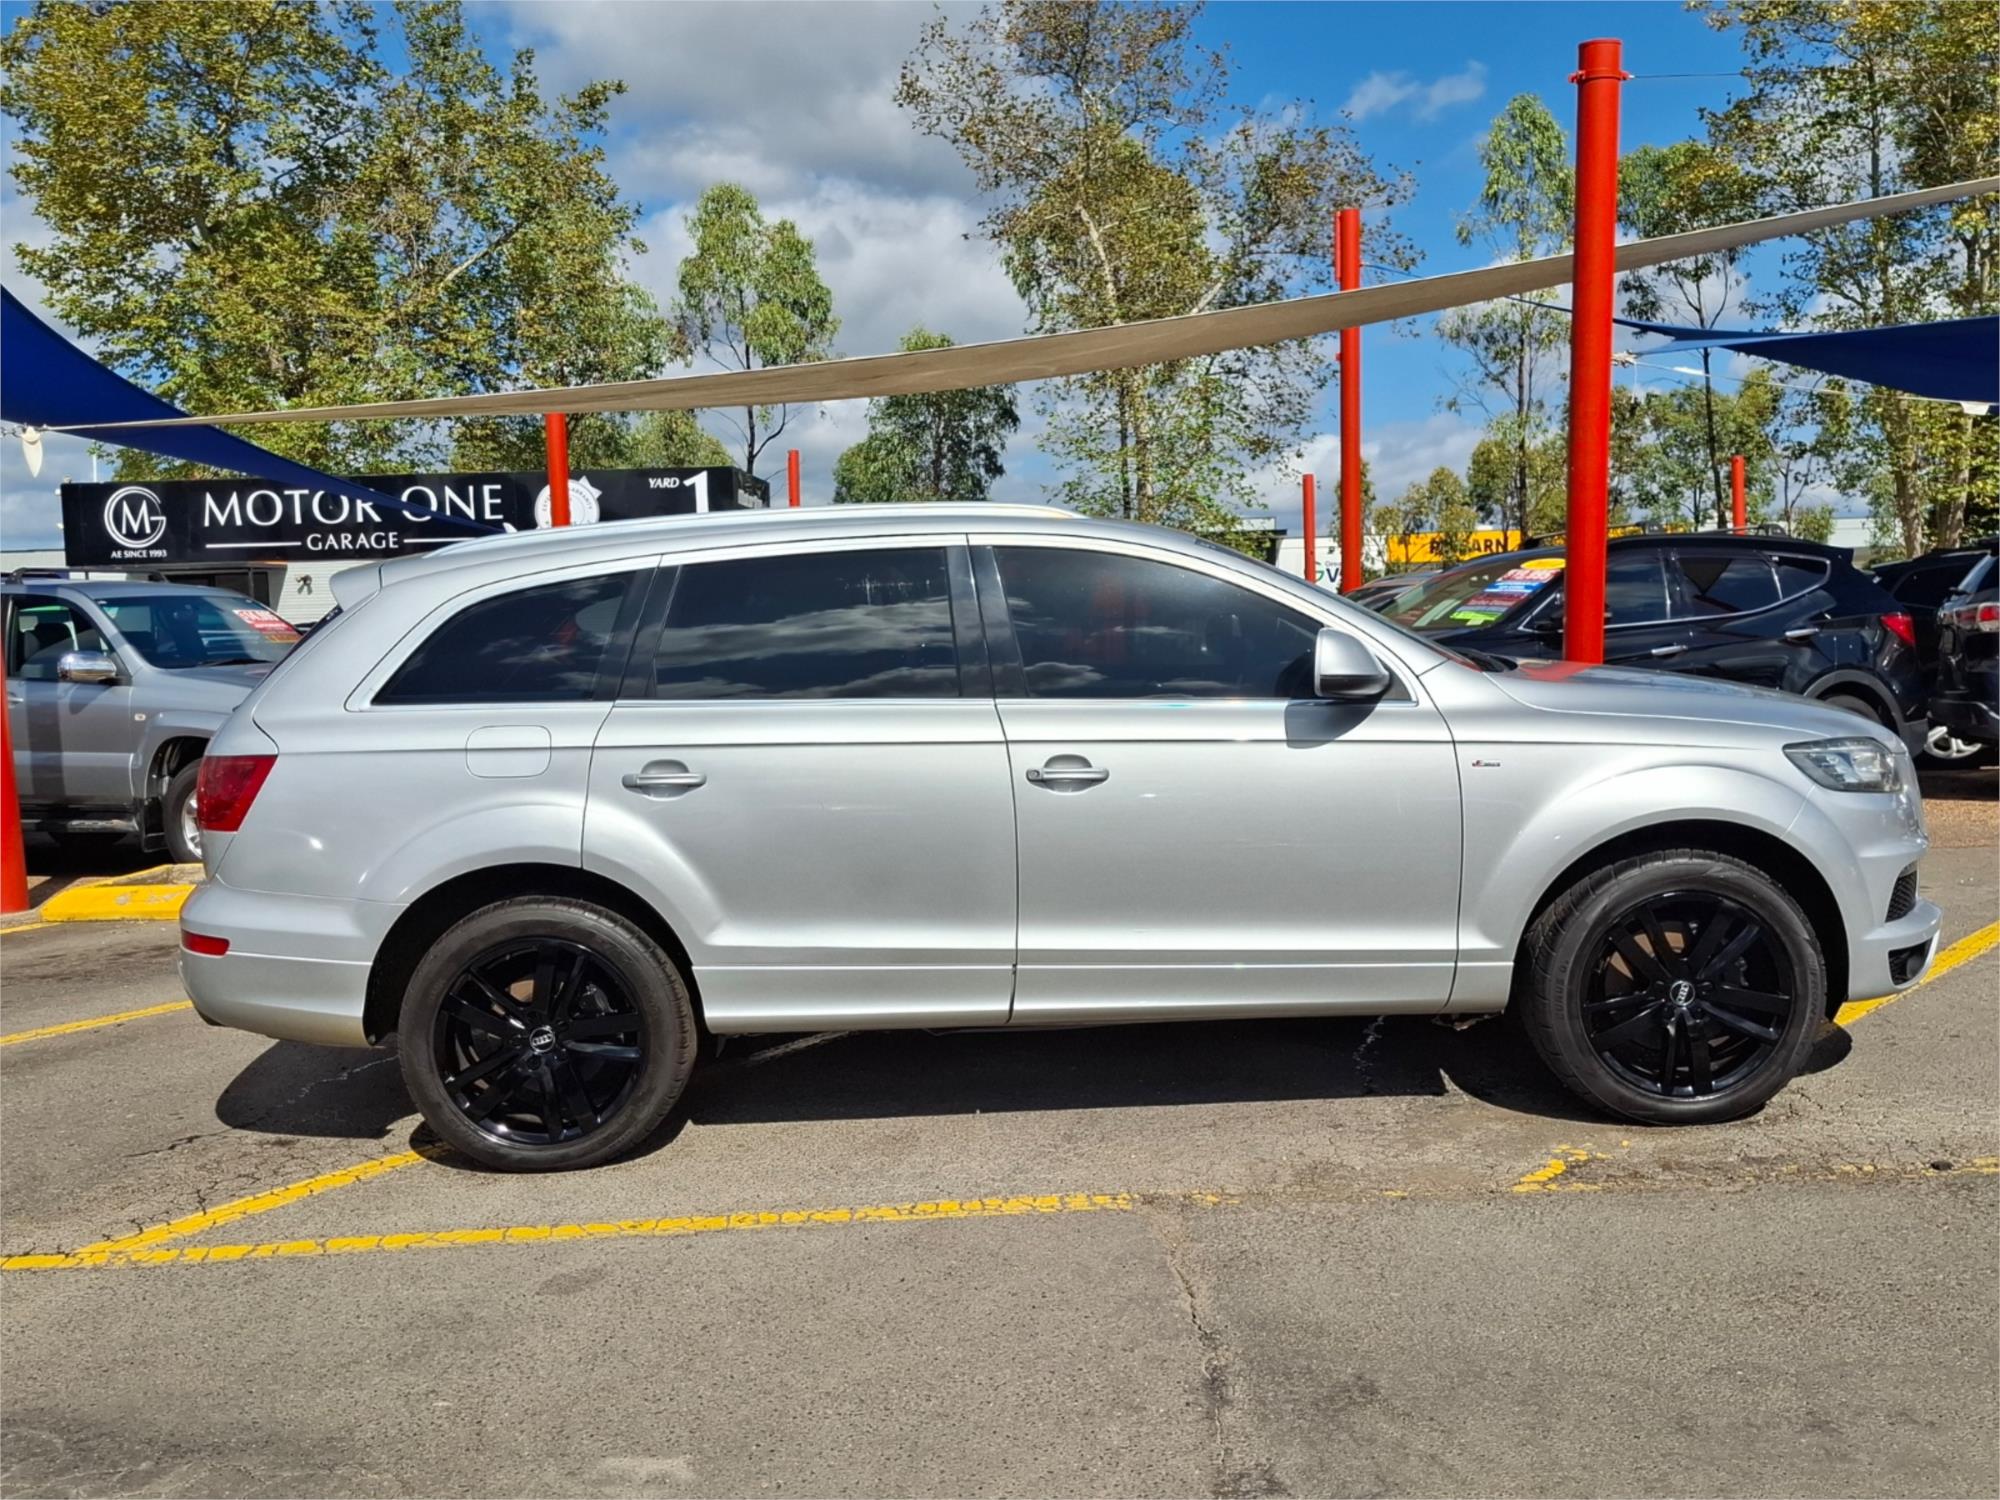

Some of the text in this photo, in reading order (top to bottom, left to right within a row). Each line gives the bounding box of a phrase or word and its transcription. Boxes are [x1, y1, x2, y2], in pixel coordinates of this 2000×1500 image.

[204, 488, 382, 528] MOTOR
[401, 484, 504, 522] ONE
[648, 470, 709, 514] YARD 1
[111, 549, 168, 559] AE SINCE 1993
[306, 531, 399, 550] GARAGE
